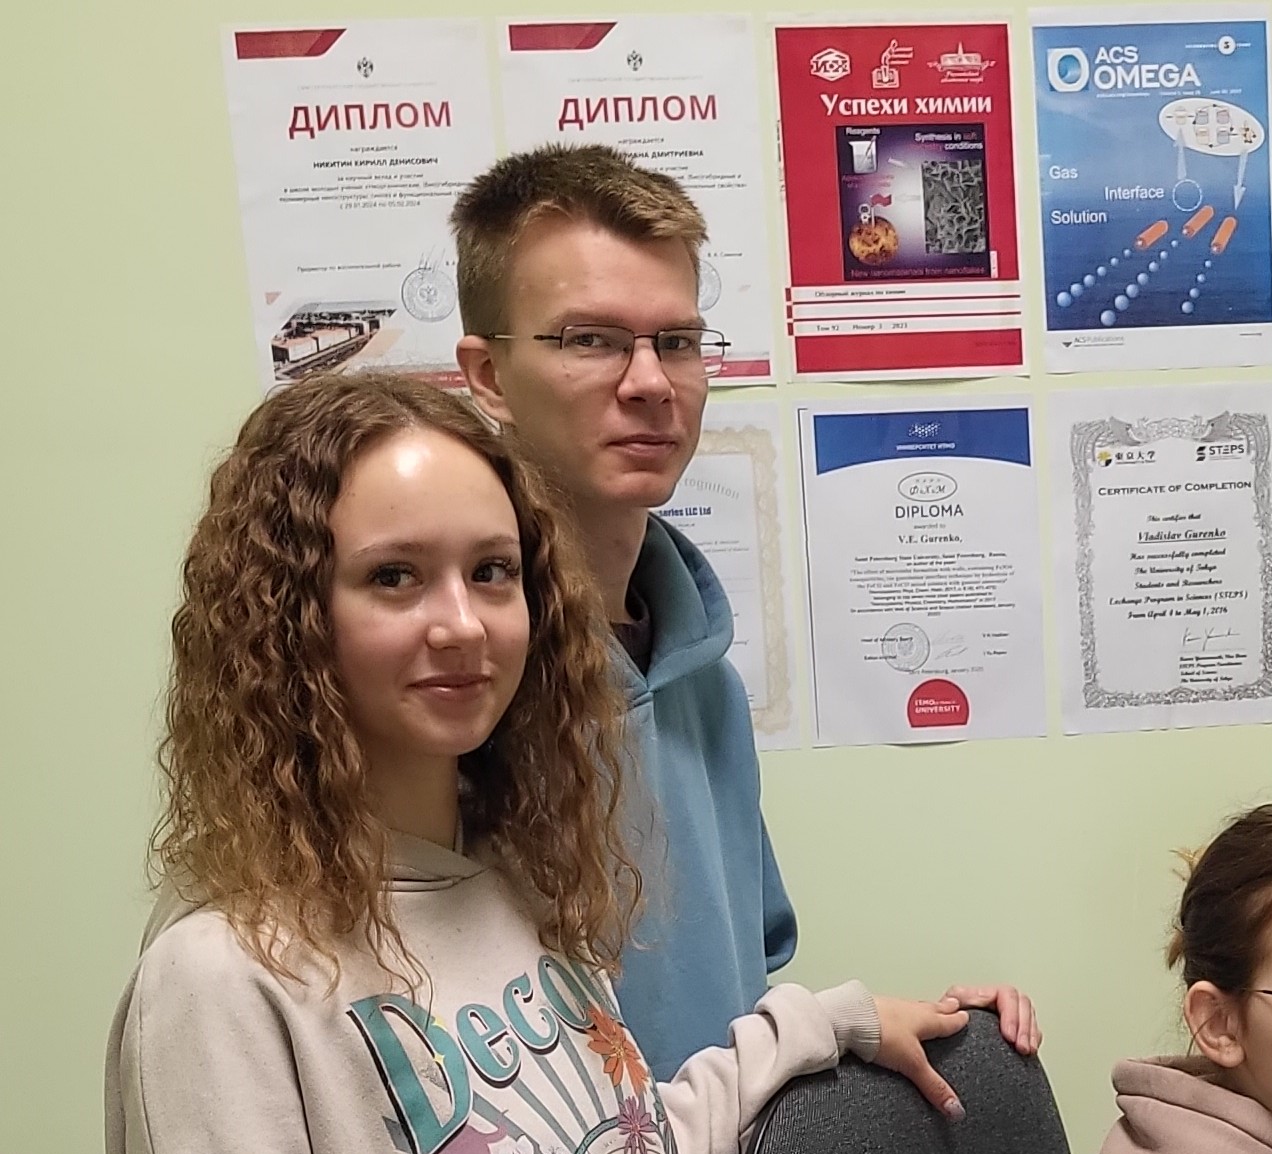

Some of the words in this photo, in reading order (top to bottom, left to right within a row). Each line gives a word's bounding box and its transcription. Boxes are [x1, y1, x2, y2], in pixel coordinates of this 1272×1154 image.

[1095, 46, 1138, 64] ACS
[1094, 63, 1201, 90] OMEGA
[820, 93, 908, 117] Успехи
[915, 95, 992, 115] химии
[289, 101, 452, 140] ДИПЛОМ
[558, 95, 718, 131] ДИПЛОМ
[944, 142, 983, 151] conditions
[651, 150, 703, 159] ДМИТРИЕВНА
[313, 160, 352, 169] НИКИТИН
[355, 159, 388, 167] КИРИЛЛ
[389, 157, 438, 167] ДЕНИСОВИЧ
[1049, 165, 1078, 180] Gas
[1104, 186, 1165, 201] Interface
[1051, 208, 1107, 225] Solution
[1208, 444, 1245, 455] STEPS
[685, 507, 698, 517] LLC
[699, 506, 712, 516] Ltd
[895, 503, 964, 520] DIPLOMA
[920, 533, 963, 544] Gurenko,
[1137, 530, 1183, 543] Vladislav
[1184, 527, 1227, 540] Gurenko
[914, 704, 961, 714] UNIVERSITY
